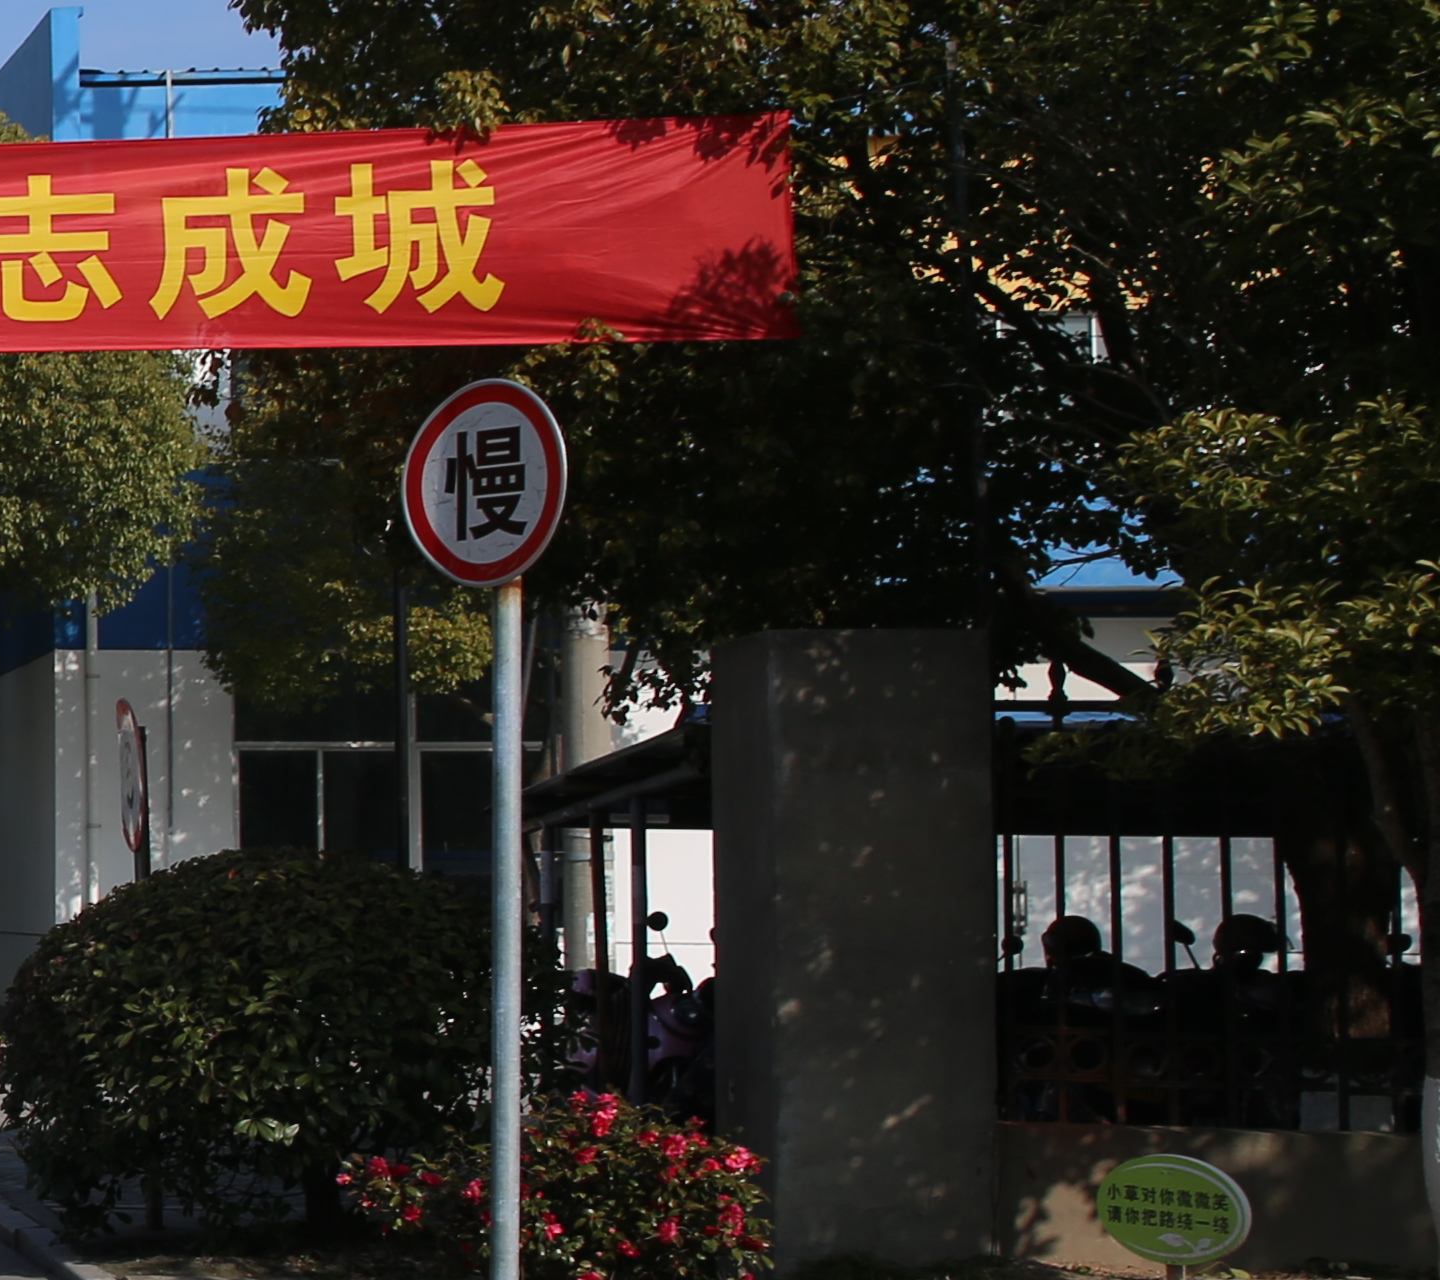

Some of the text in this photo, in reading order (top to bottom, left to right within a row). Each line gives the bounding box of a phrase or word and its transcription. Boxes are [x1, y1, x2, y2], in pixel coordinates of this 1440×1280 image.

[443, 424, 529, 542] 慢
[1106, 1183, 1230, 1212] 小草对你微微笑
[1106, 1205, 1230, 1235] 请你把路绕一绕
